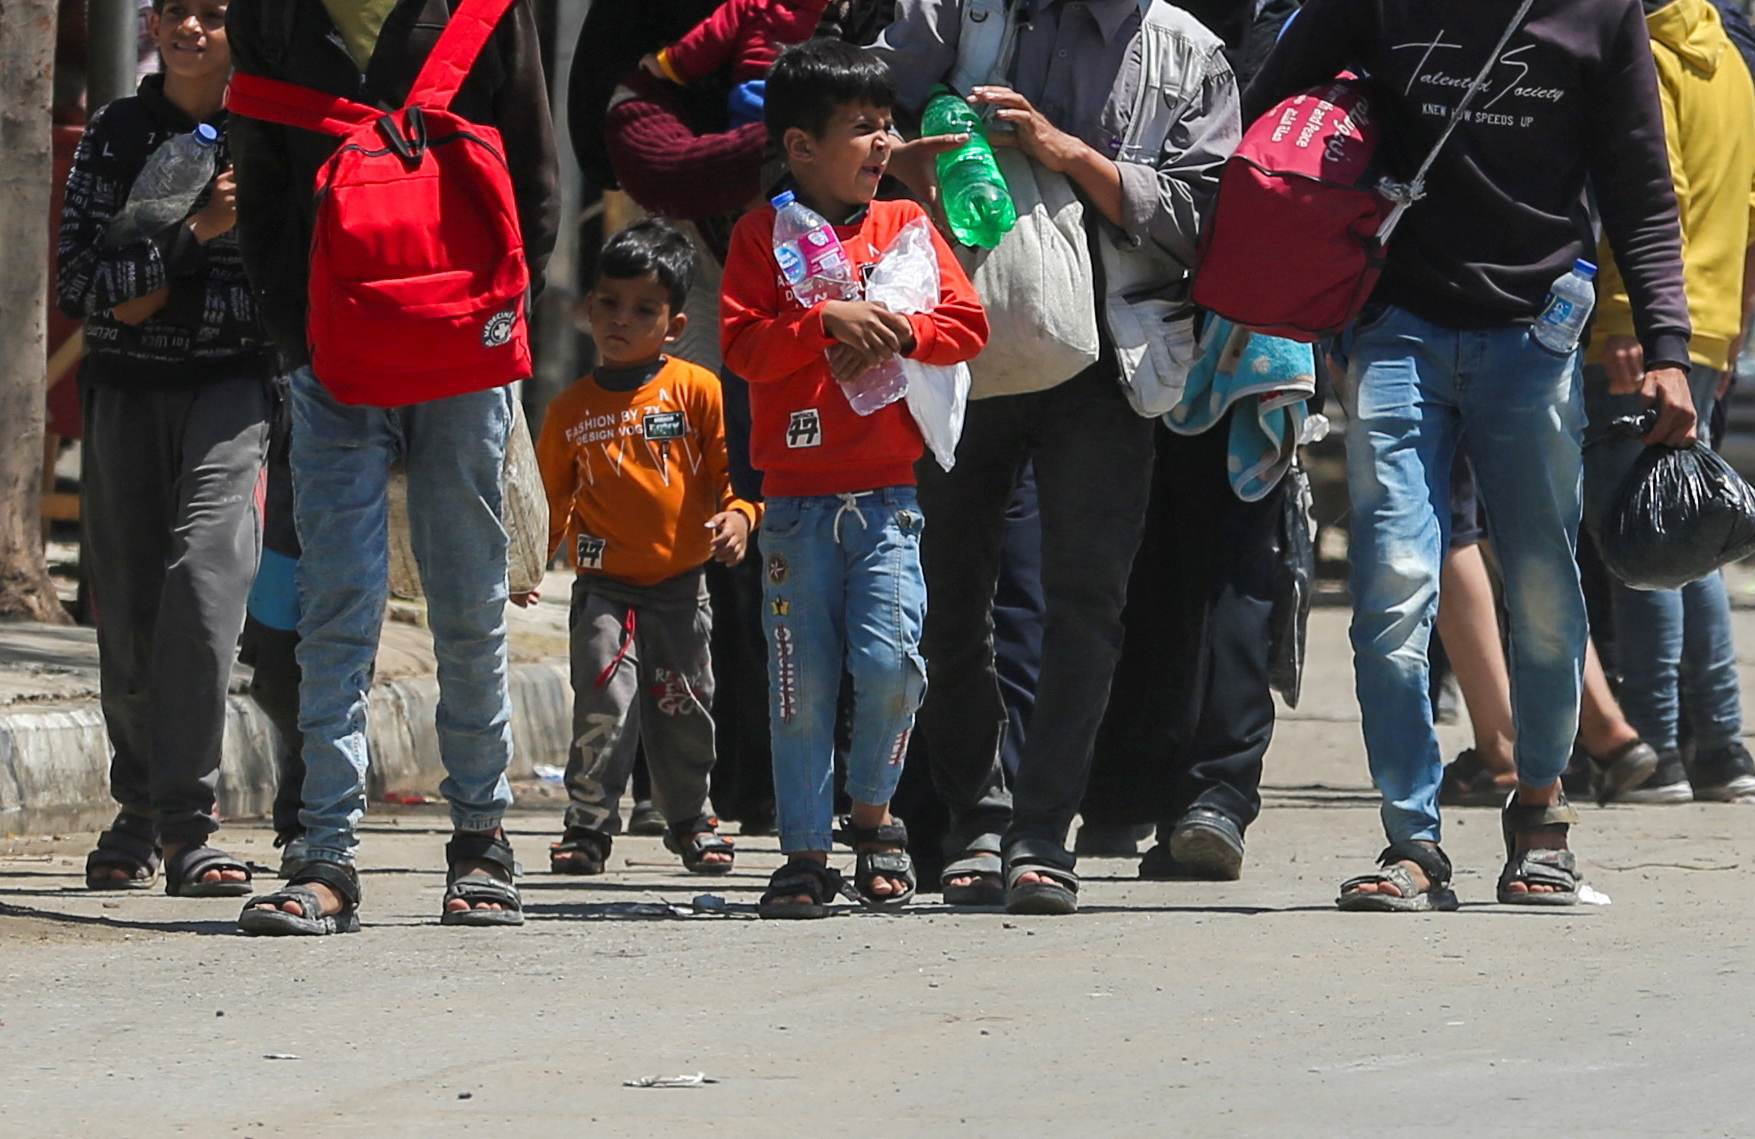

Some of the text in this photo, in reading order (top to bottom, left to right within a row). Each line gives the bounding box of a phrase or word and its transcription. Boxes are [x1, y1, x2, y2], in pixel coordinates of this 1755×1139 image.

[1483, 43, 1565, 110] Society
[1422, 103, 1447, 118] KNEW
[1475, 111, 1514, 127] SPEEDS
[1520, 116, 1534, 128] UP
[1296, 122, 1320, 148] Peace
[565, 413, 616, 443] FASHION
[621, 410, 639, 423] BY
[576, 428, 615, 446] DESIGN
